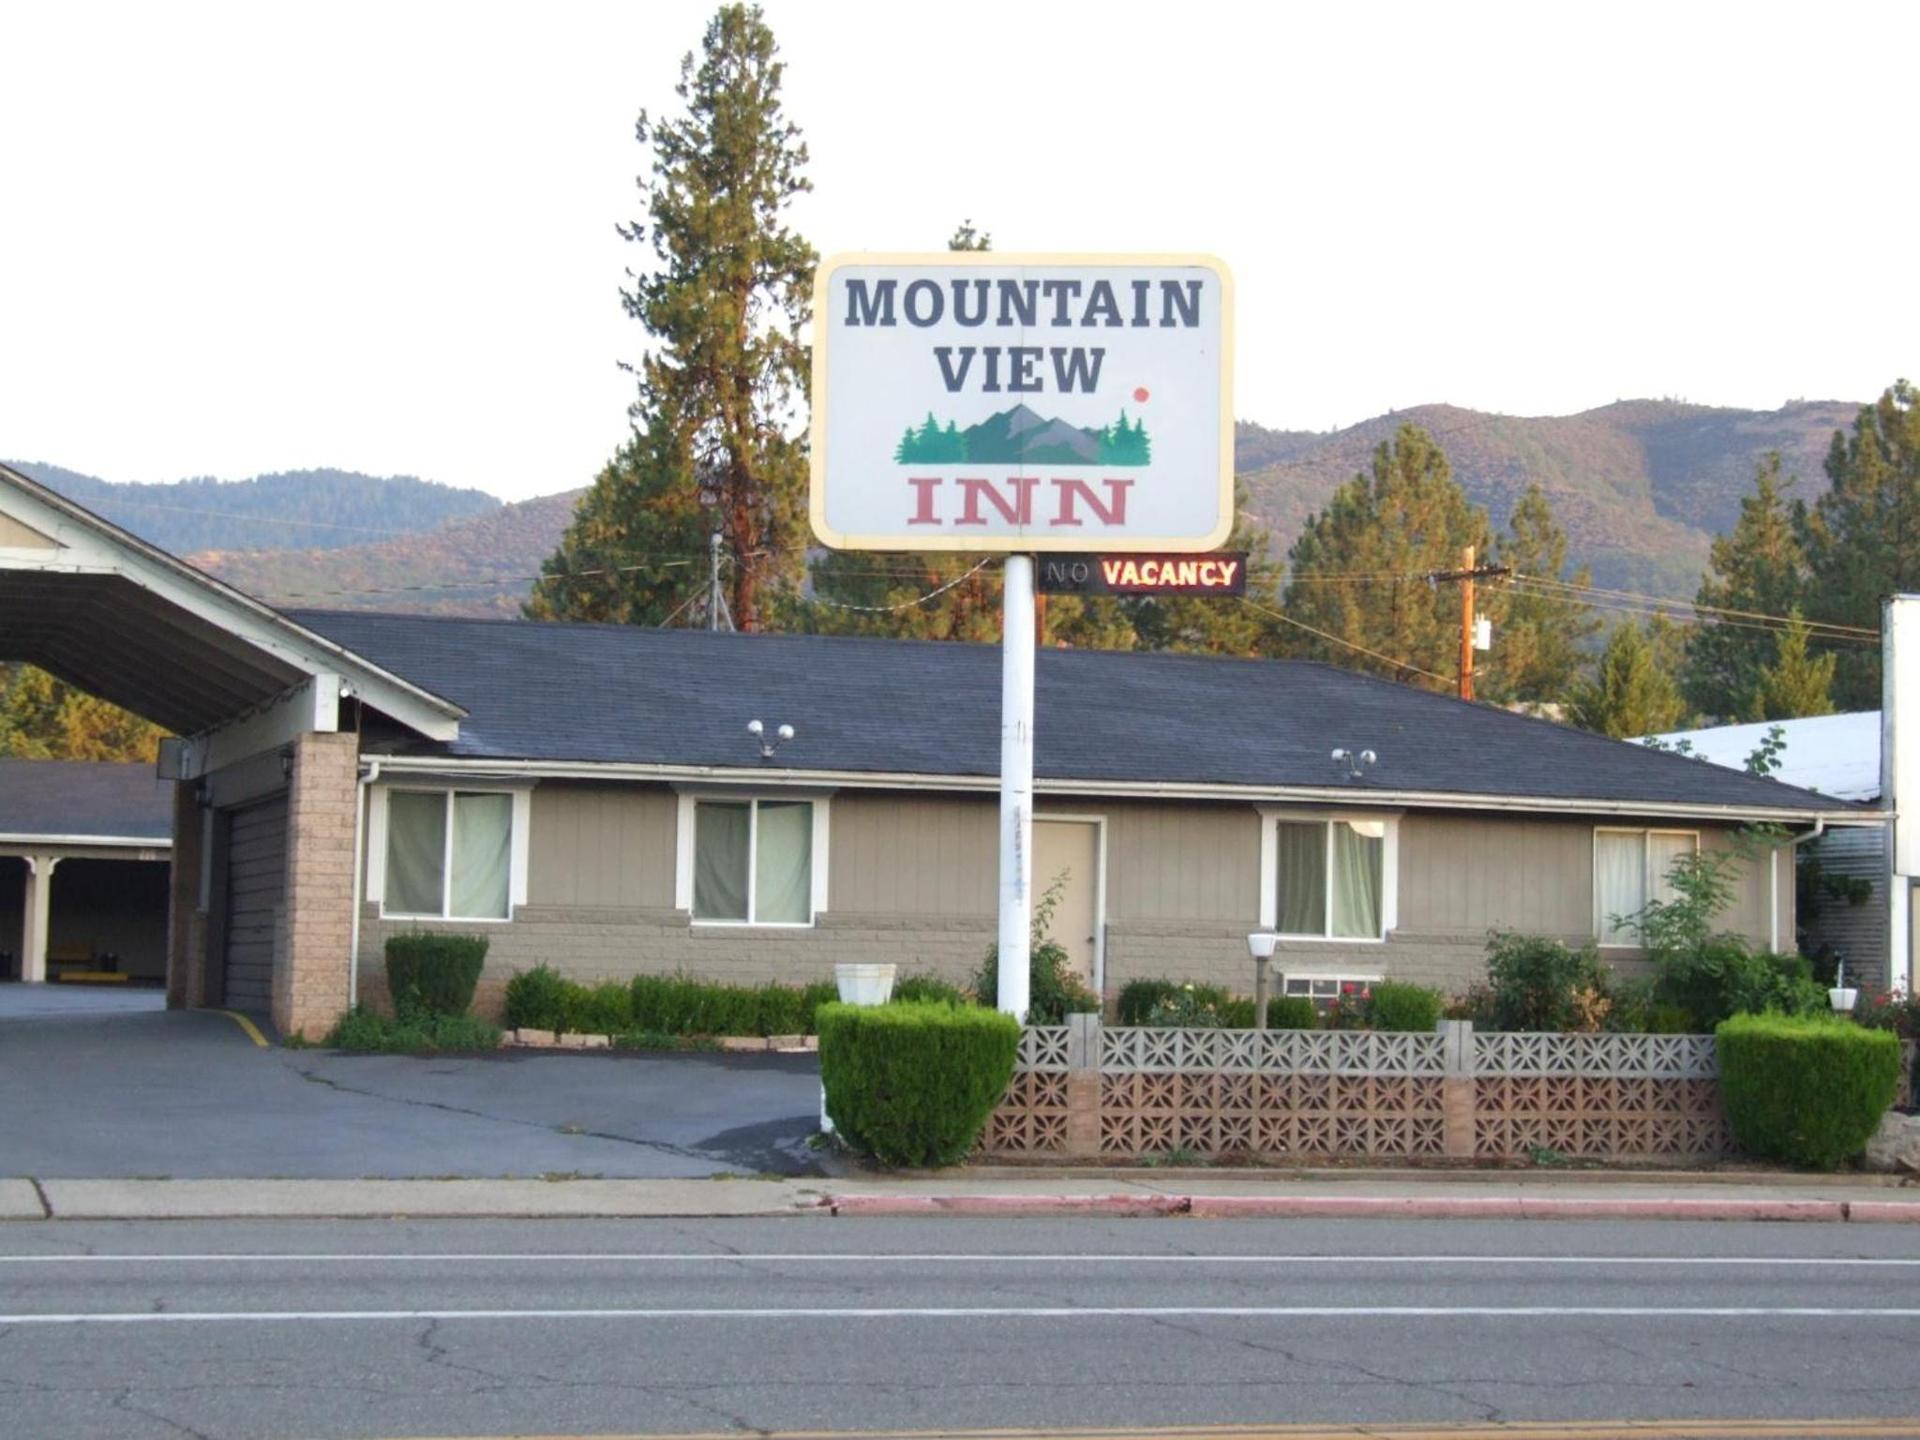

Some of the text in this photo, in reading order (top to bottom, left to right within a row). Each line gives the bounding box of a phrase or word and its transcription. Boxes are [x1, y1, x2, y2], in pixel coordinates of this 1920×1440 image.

[845, 279, 1203, 328] MOUNTAIN
[933, 346, 1106, 393] VIEW
[907, 477, 1135, 526] INN
[1047, 560, 1237, 586] NO VACANCY
